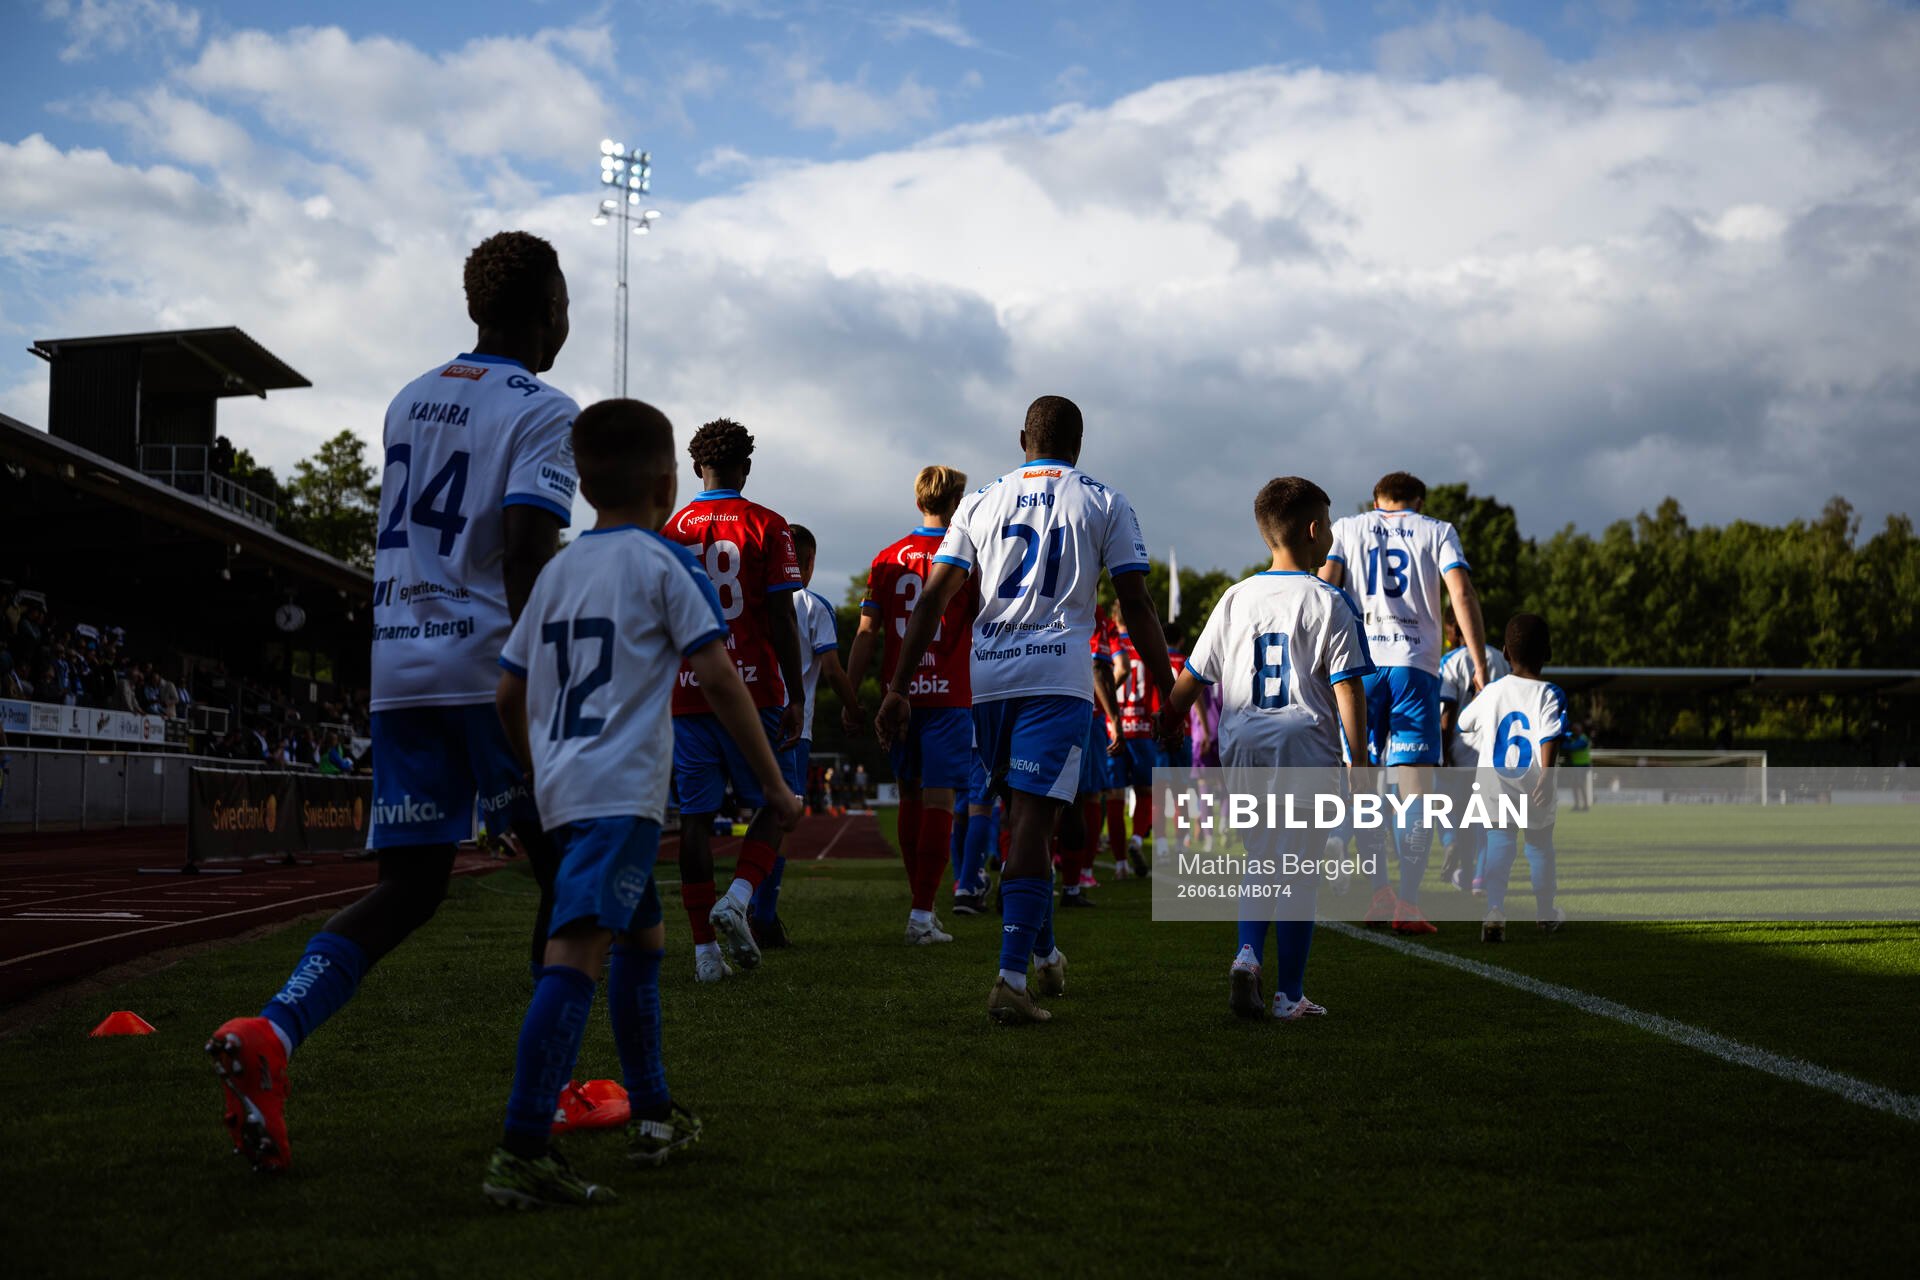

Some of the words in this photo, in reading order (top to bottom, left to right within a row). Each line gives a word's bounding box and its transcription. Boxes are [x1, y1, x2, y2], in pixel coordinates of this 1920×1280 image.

[408, 401, 470, 427] KAMARA
[378, 443, 470, 557] 24
[687, 513, 739, 526] NPSolution
[906, 551, 935, 560] NPSolu
[998, 523, 1066, 599] 21
[1366, 547, 1409, 598] 13
[371, 623, 420, 641] ärnamo
[424, 616, 474, 638] Energi
[975, 647, 1021, 661] Värnamo
[1025, 643, 1067, 656] Energi
[1252, 632, 1291, 709] 8
[542, 618, 615, 741] 12
[1492, 711, 1533, 779] 6
[1010, 757, 1040, 776] VEMA
